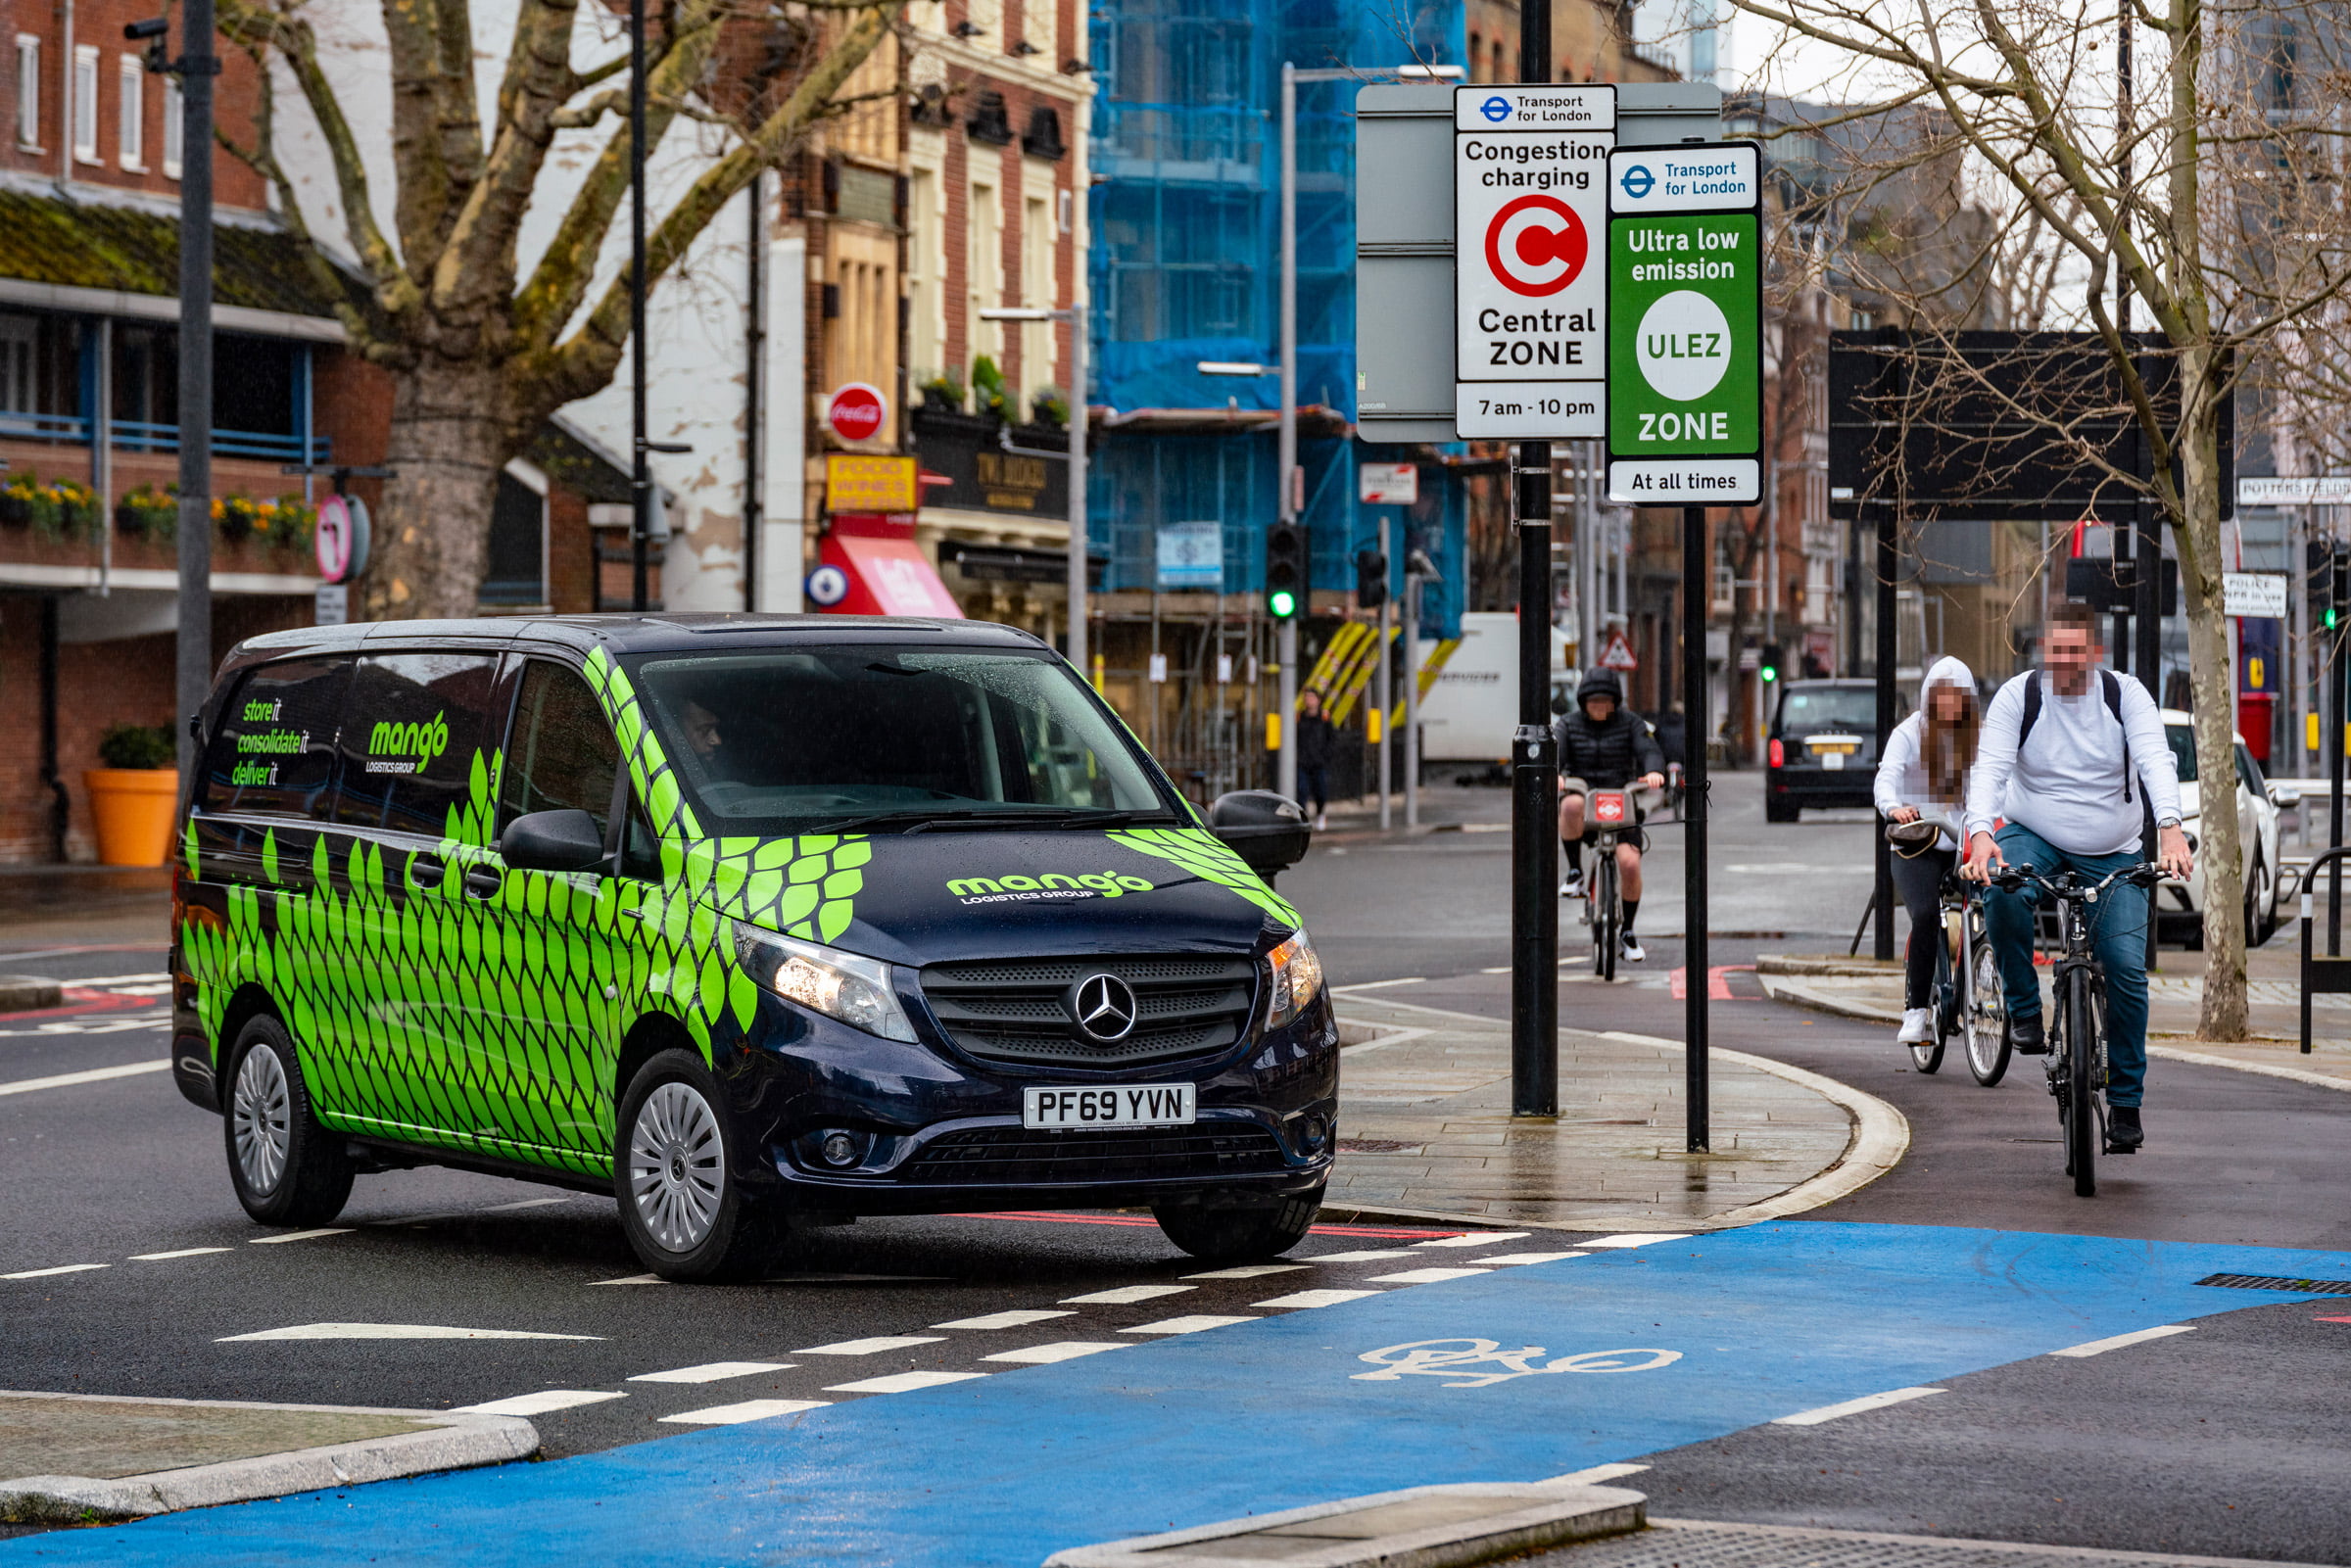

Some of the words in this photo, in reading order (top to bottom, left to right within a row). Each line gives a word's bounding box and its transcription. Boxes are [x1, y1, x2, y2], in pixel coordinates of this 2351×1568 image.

[1517, 96, 1583, 109] Transport
[1517, 111, 1537, 121] for
[1543, 110, 1592, 121] London
[1465, 140, 1607, 164] Congestion
[1482, 167, 1589, 189] charging
[1665, 162, 1737, 178] Transport
[1665, 182, 1686, 195] for
[1693, 180, 1746, 195] London
[1629, 229, 1689, 253] Ultra
[1698, 227, 1740, 250] low
[1632, 257, 1735, 281] emission
[1479, 308, 1596, 333] Central
[1490, 341, 1583, 365] ZONE
[1648, 333, 1721, 358] ULEZ
[1479, 400, 1490, 415] 7
[1494, 404, 1522, 415] am
[1539, 399, 1561, 415] 10
[1566, 403, 1595, 417] pm
[1638, 412, 1729, 441] ZONE
[838, 461, 902, 475] FOOD
[1632, 473, 1653, 490] At
[1658, 472, 1681, 490] all
[1687, 472, 1737, 490] times
[2243, 483, 2302, 495] POTTERS
[368, 709, 449, 774] mango
[946, 870, 1154, 898] mango
[960, 892, 1040, 905] LOGISTICS
[1040, 890, 1094, 899] GROUP
[1037, 1090, 1118, 1122] PF69
[1127, 1088, 1182, 1120] YVN
